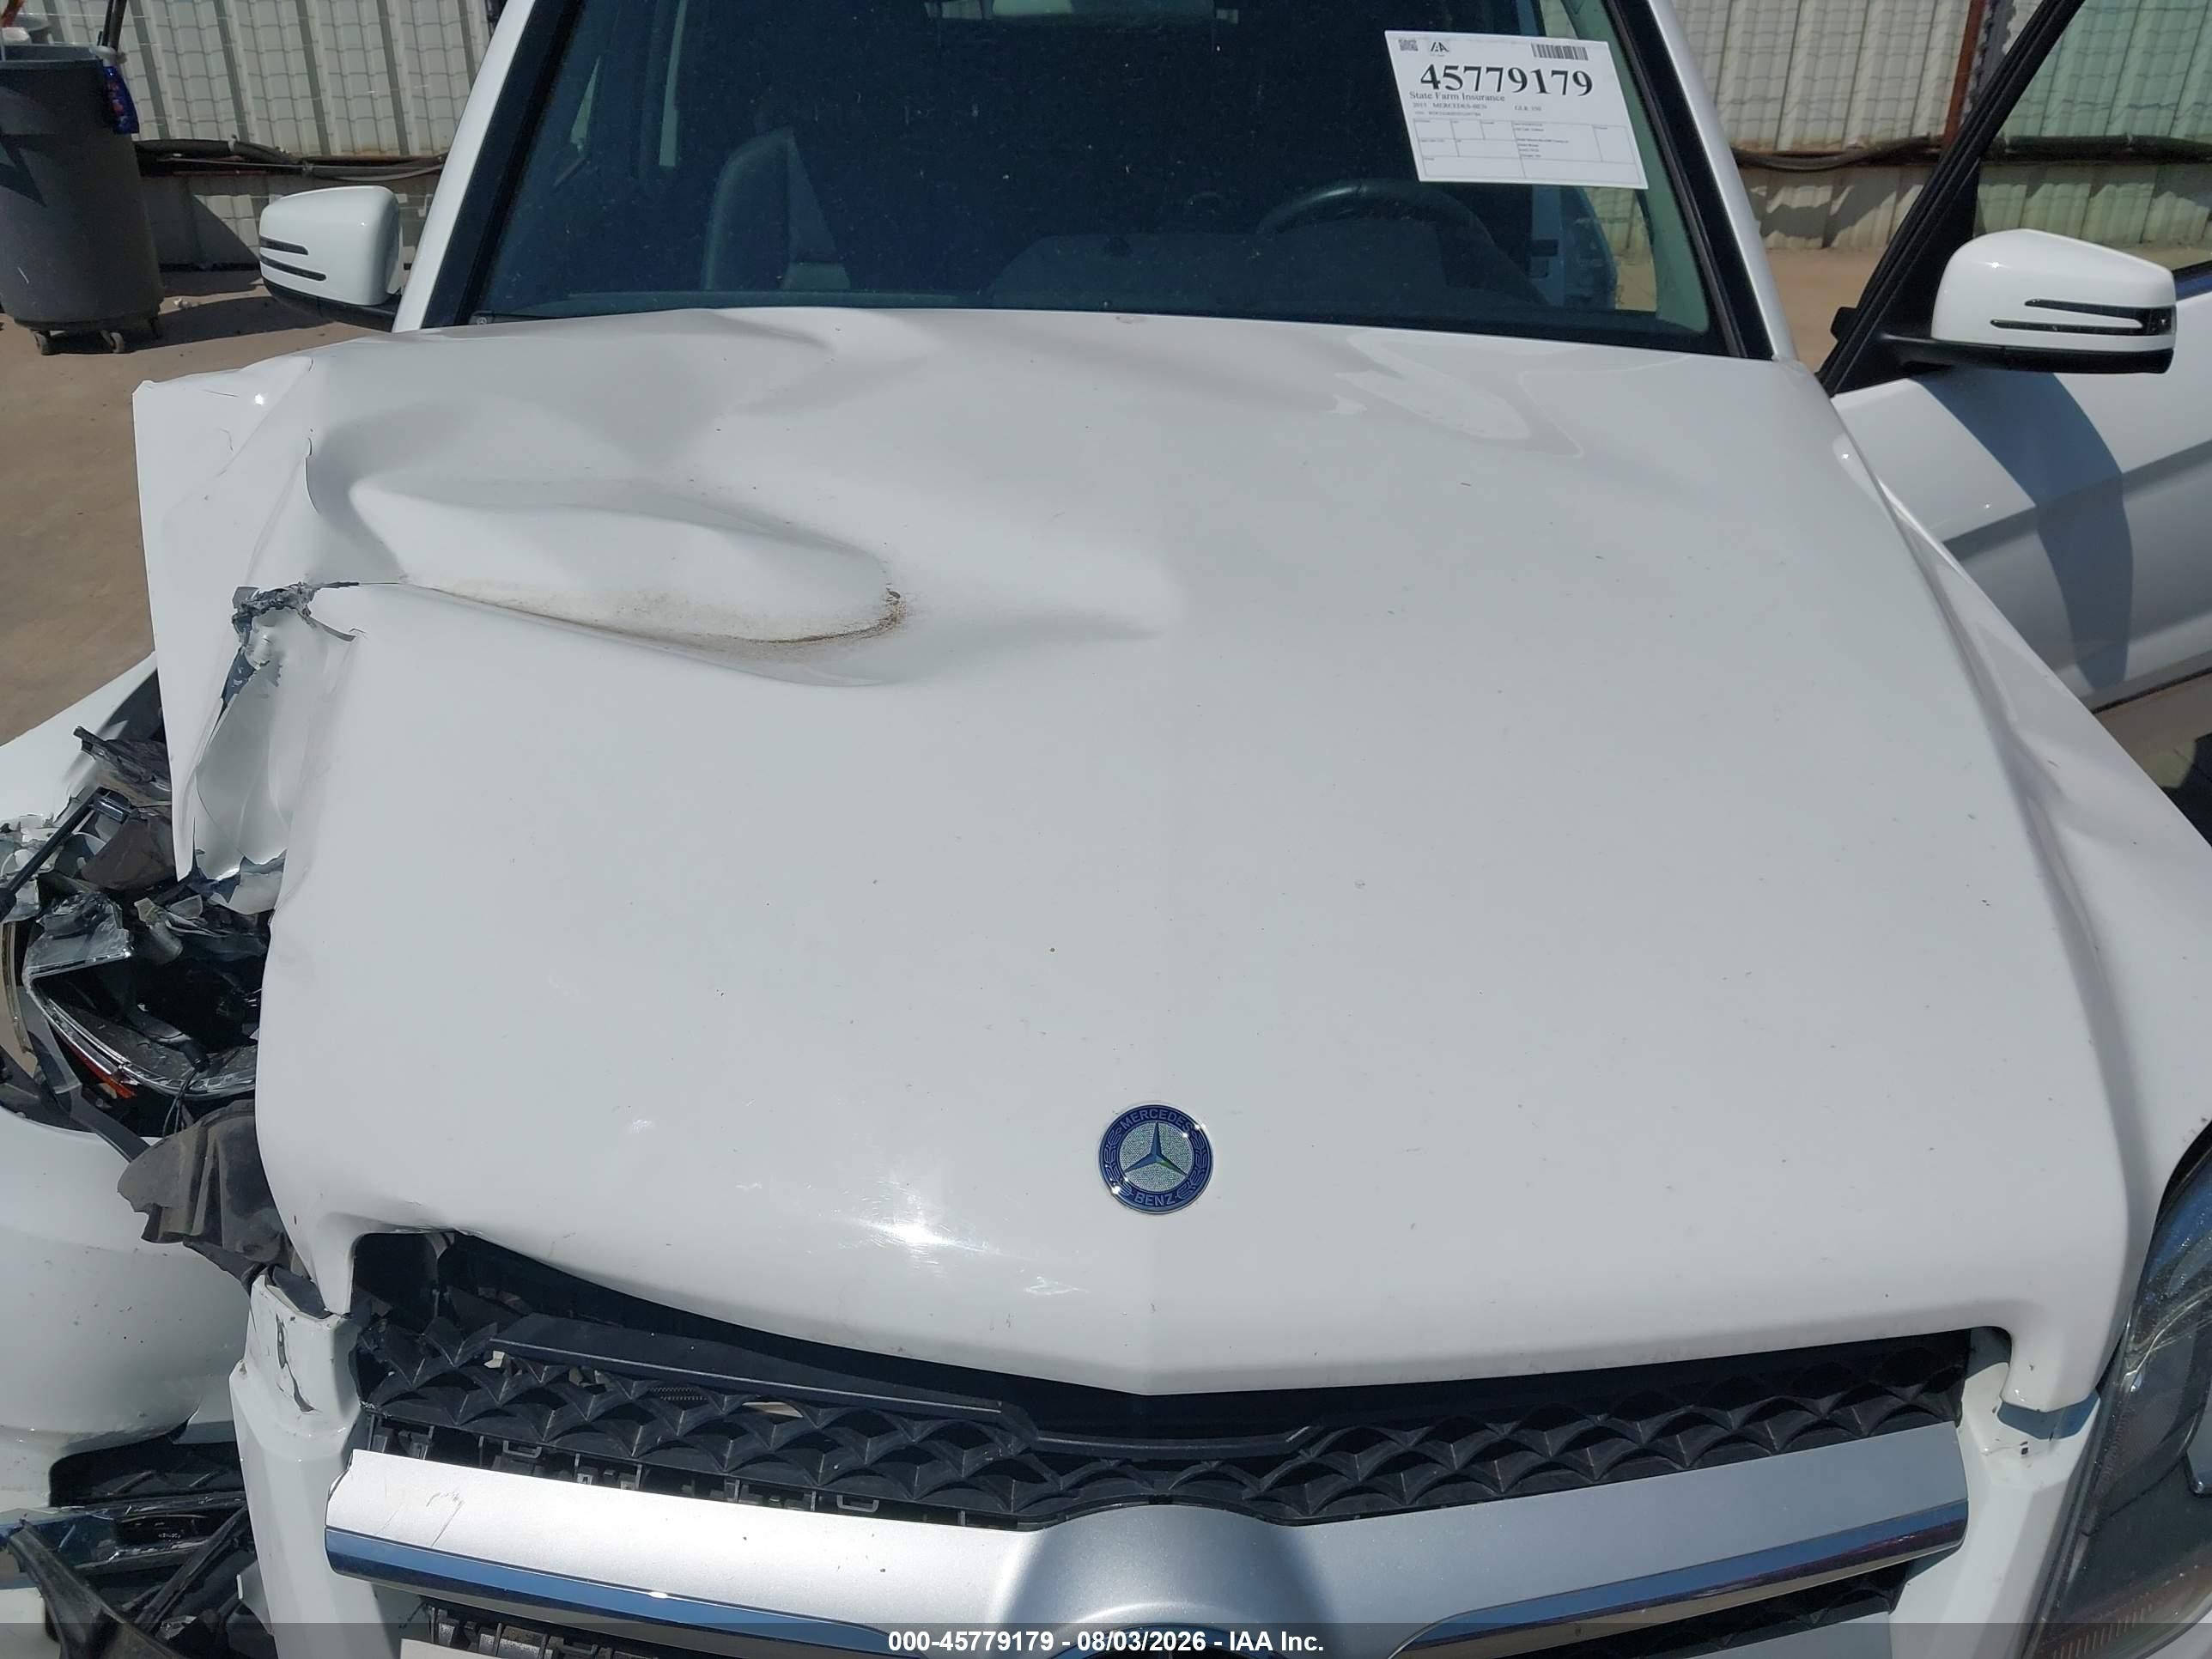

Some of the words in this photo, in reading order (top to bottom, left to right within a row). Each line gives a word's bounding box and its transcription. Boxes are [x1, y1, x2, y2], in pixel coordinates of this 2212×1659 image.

[1420, 64, 1593, 96] 45779179
[1409, 90, 1433, 100] State
[1435, 92, 1460, 101] Farm
[1462, 93, 1505, 102] Insurance
[1121, 1109, 1194, 1131] MERCEDES
[1134, 1193, 1176, 1206] BENZ
